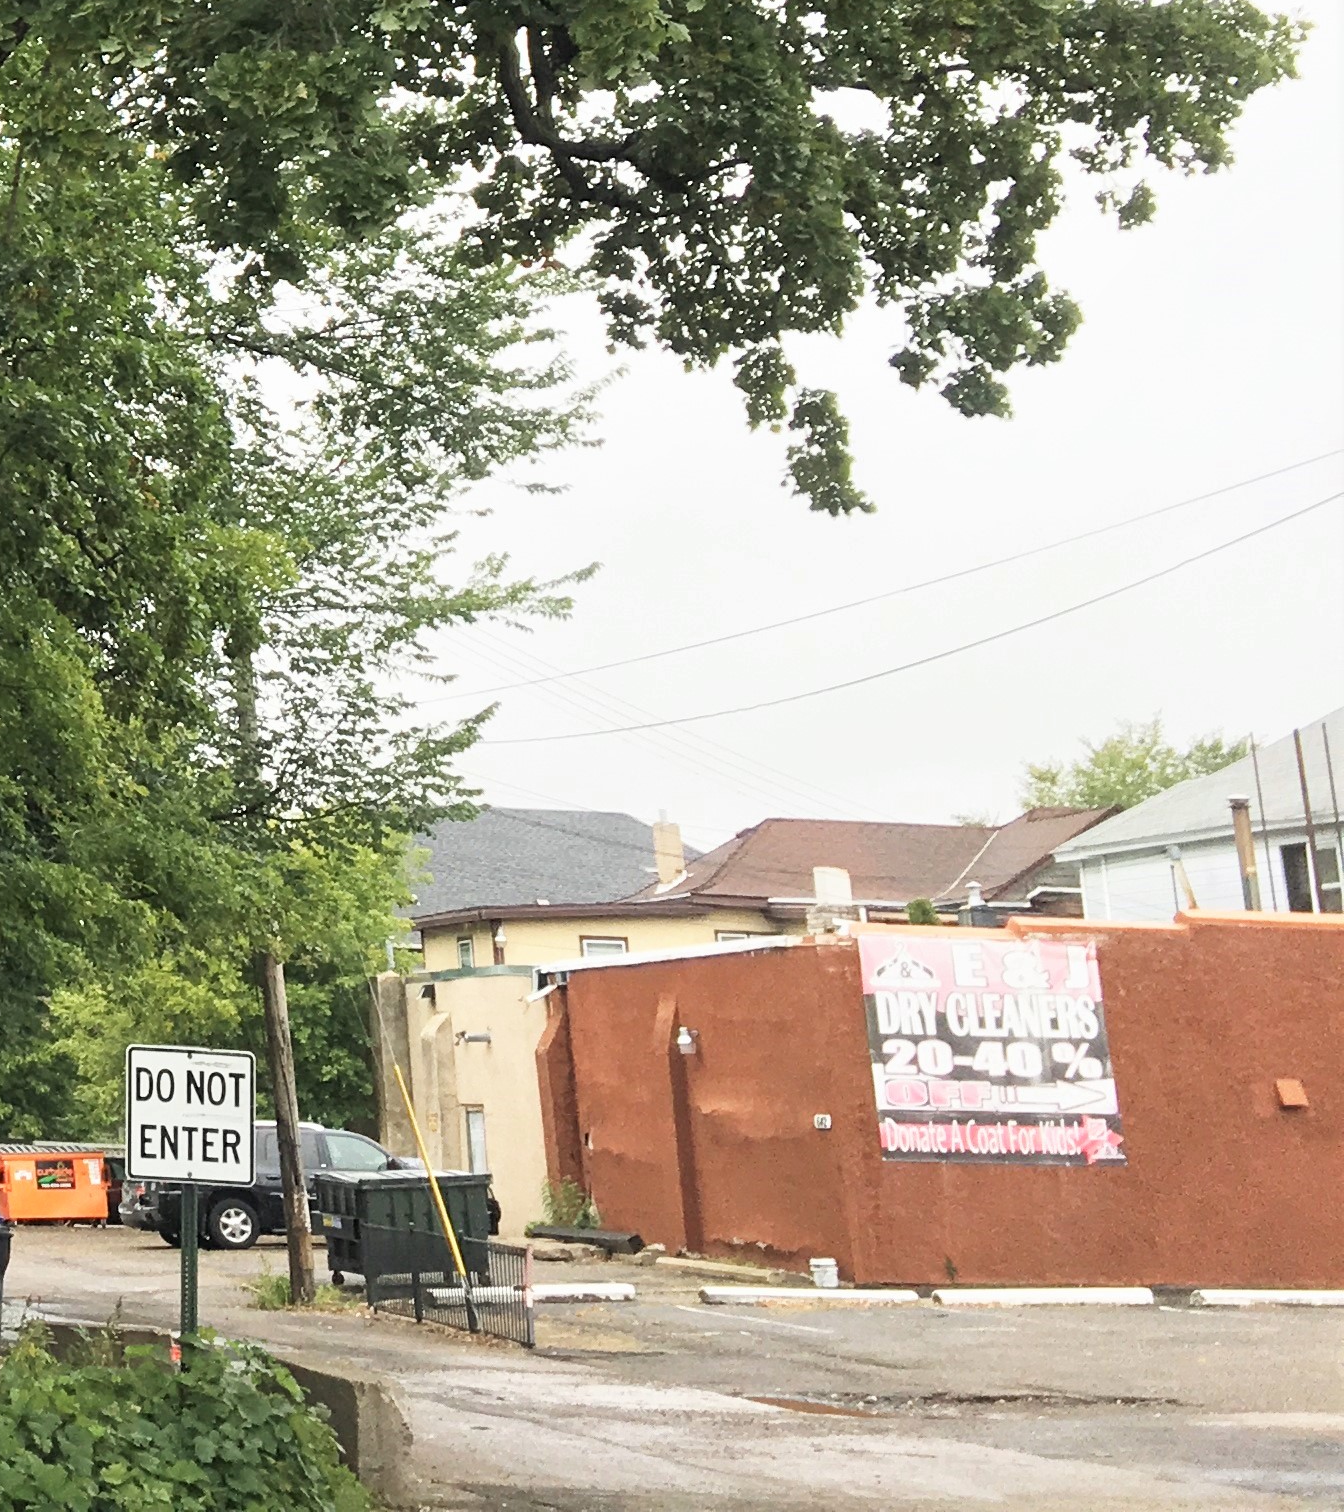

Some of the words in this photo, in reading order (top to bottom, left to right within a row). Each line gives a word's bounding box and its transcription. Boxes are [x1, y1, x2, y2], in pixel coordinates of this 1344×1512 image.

[900, 961, 912, 978] &
[951, 943, 988, 987] E
[1002, 950, 1052, 989] &
[1065, 945, 1090, 989] J
[875, 990, 938, 1036] DRY
[946, 992, 1099, 1040] CLEANERS
[882, 1039, 1043, 1077] 20-40
[1051, 1041, 1103, 1079] %
[135, 1067, 175, 1103] DO
[186, 1070, 246, 1107] NOT
[140, 1124, 241, 1164] ENTER
[884, 1117, 947, 1154] Donate
[951, 1119, 965, 1153] A
[966, 1119, 1007, 1155] Coat
[1008, 1119, 1037, 1155] For
[1039, 1118, 1082, 1156] Kids!
